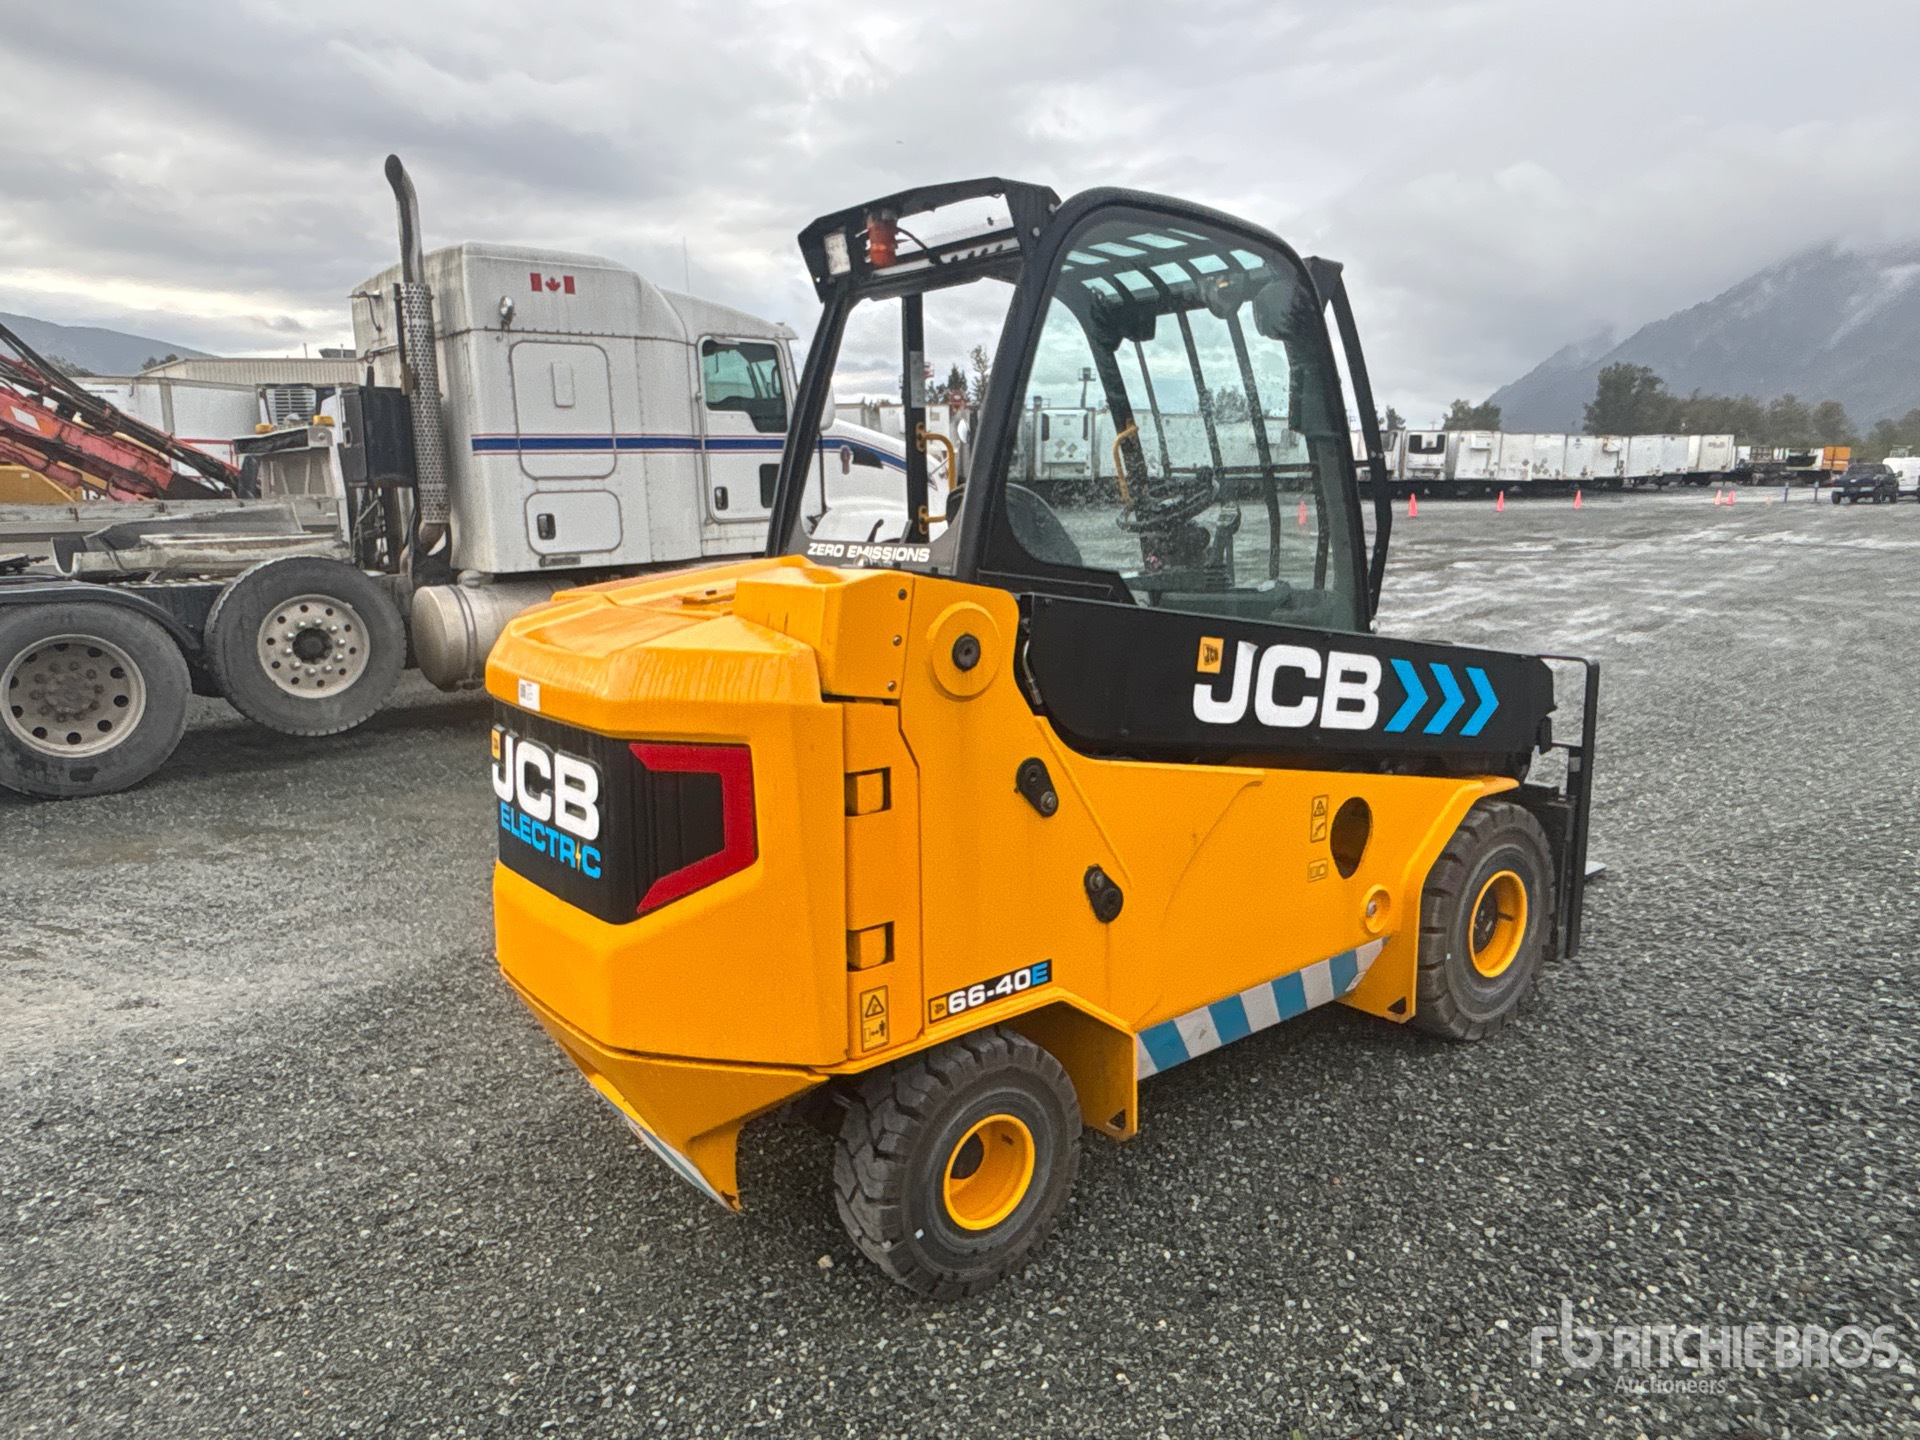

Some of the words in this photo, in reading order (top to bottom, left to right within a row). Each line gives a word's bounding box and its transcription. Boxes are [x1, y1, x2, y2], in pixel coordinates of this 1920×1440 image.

[807, 542, 844, 558] ZERO
[847, 545, 930, 562] EMISSIONS
[1193, 640, 1382, 730] JCB
[492, 735, 600, 840] JCB
[948, 962, 1049, 1014] 66-40E
